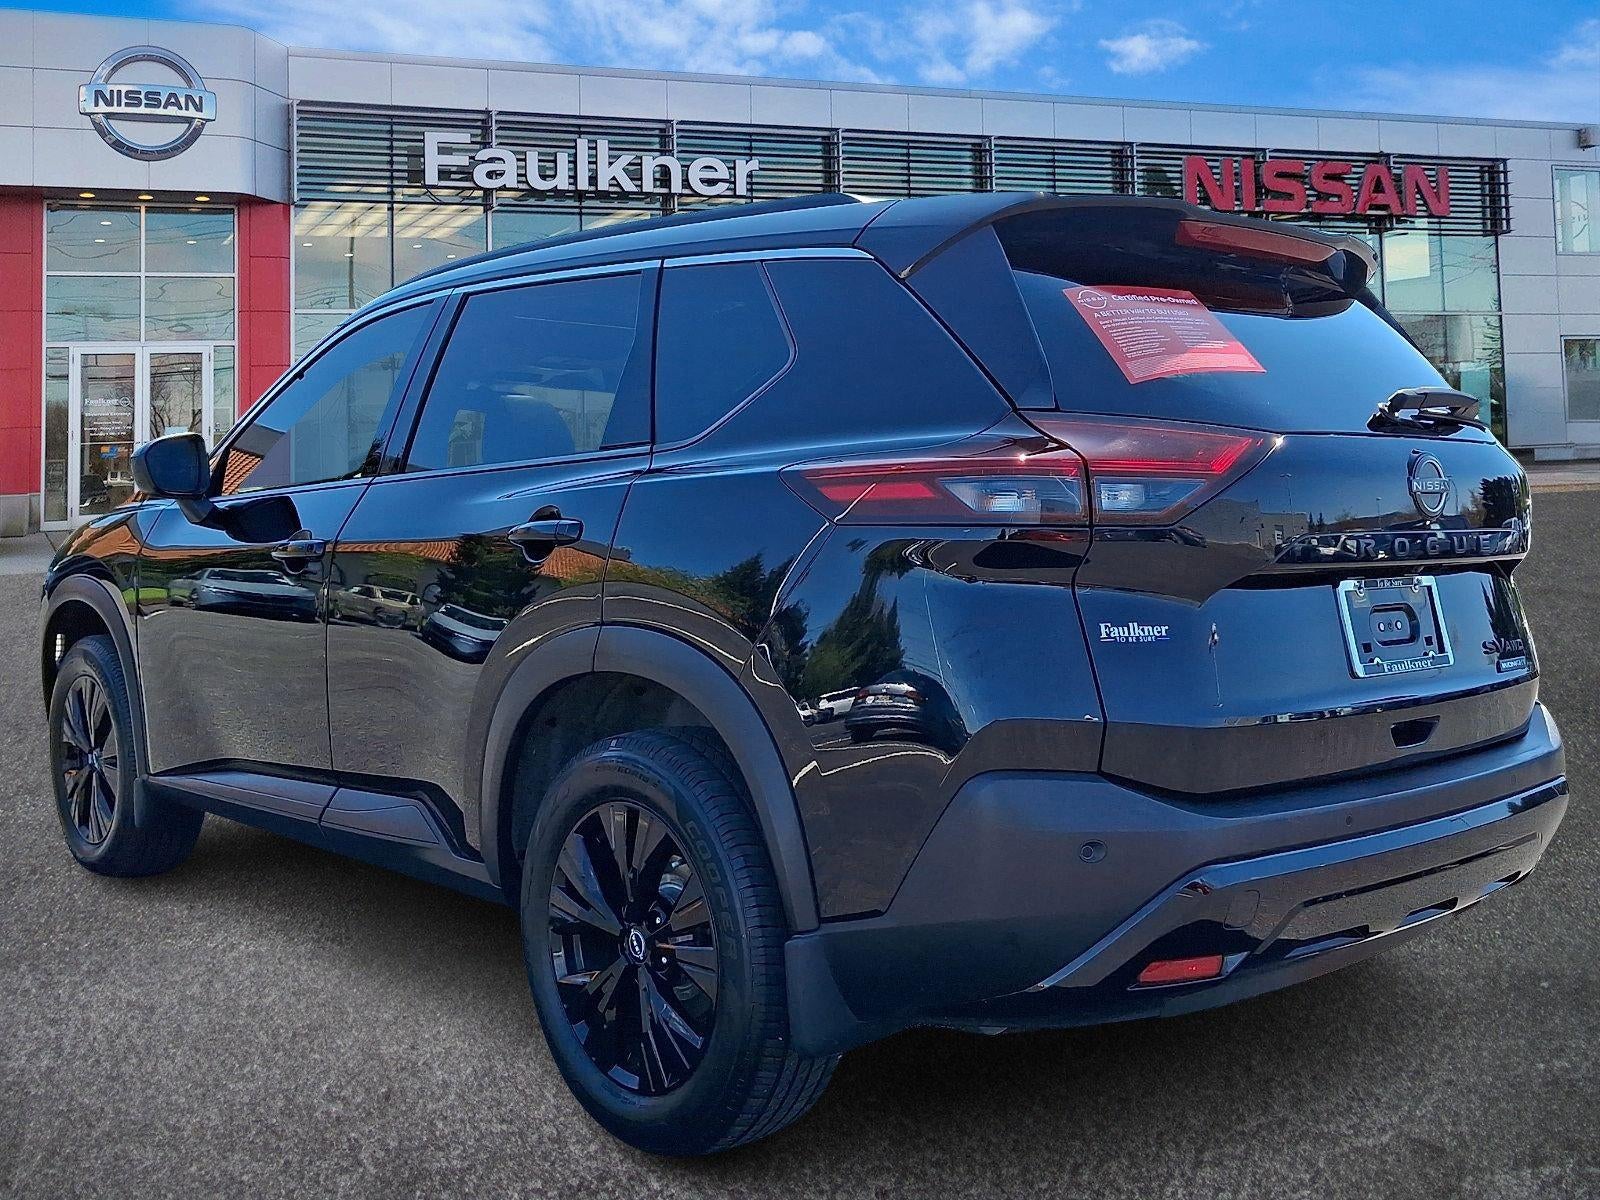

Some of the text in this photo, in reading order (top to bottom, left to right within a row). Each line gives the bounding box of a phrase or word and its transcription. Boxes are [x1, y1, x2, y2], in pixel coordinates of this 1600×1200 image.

[94, 89, 203, 113] NISSAN
[423, 131, 760, 197] Faulkner
[1182, 155, 1451, 217] NISSAN
[1111, 294, 1198, 305] Certified Pre-Owned
[1101, 309, 1130, 317] BETTER
[1358, 534, 1491, 559] ROGUE
[1099, 622, 1169, 638] Faulkner
[1383, 658, 1433, 673] Faulkner
[685, 819, 738, 961] COOPER
